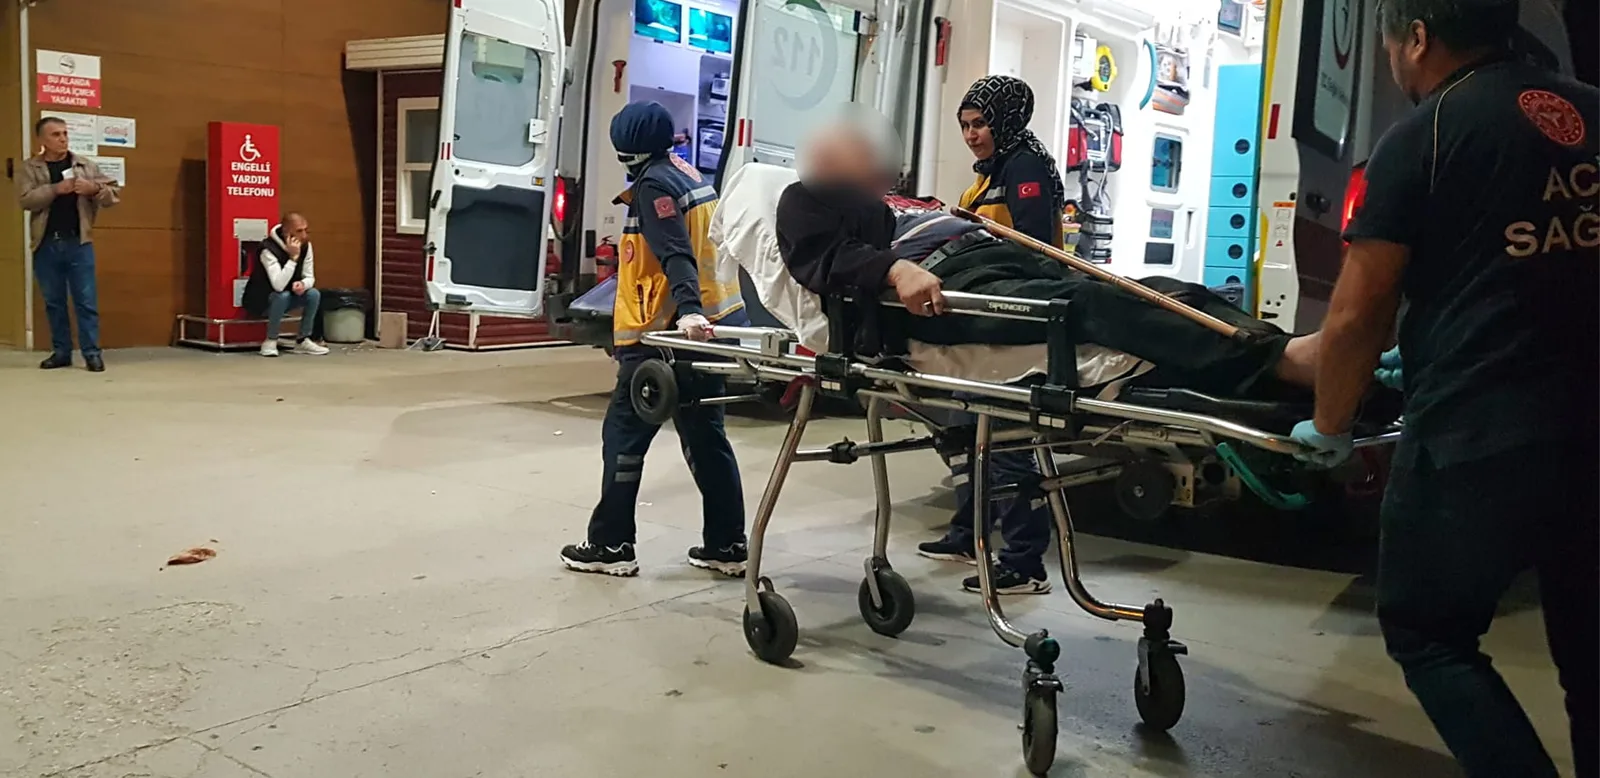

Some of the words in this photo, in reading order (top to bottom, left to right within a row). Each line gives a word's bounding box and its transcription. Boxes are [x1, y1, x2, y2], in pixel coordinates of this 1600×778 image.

[47, 75, 59, 84] BU
[60, 77, 91, 87] ALANDA
[50, 95, 88, 106] YASAKTIR
[231, 161, 271, 173] ENGELLİ
[231, 174, 270, 185] YARDIM
[1542, 155, 1599, 201] AC
[226, 186, 275, 197] TELEFONU
[988, 301, 1030, 312] SPENCER
